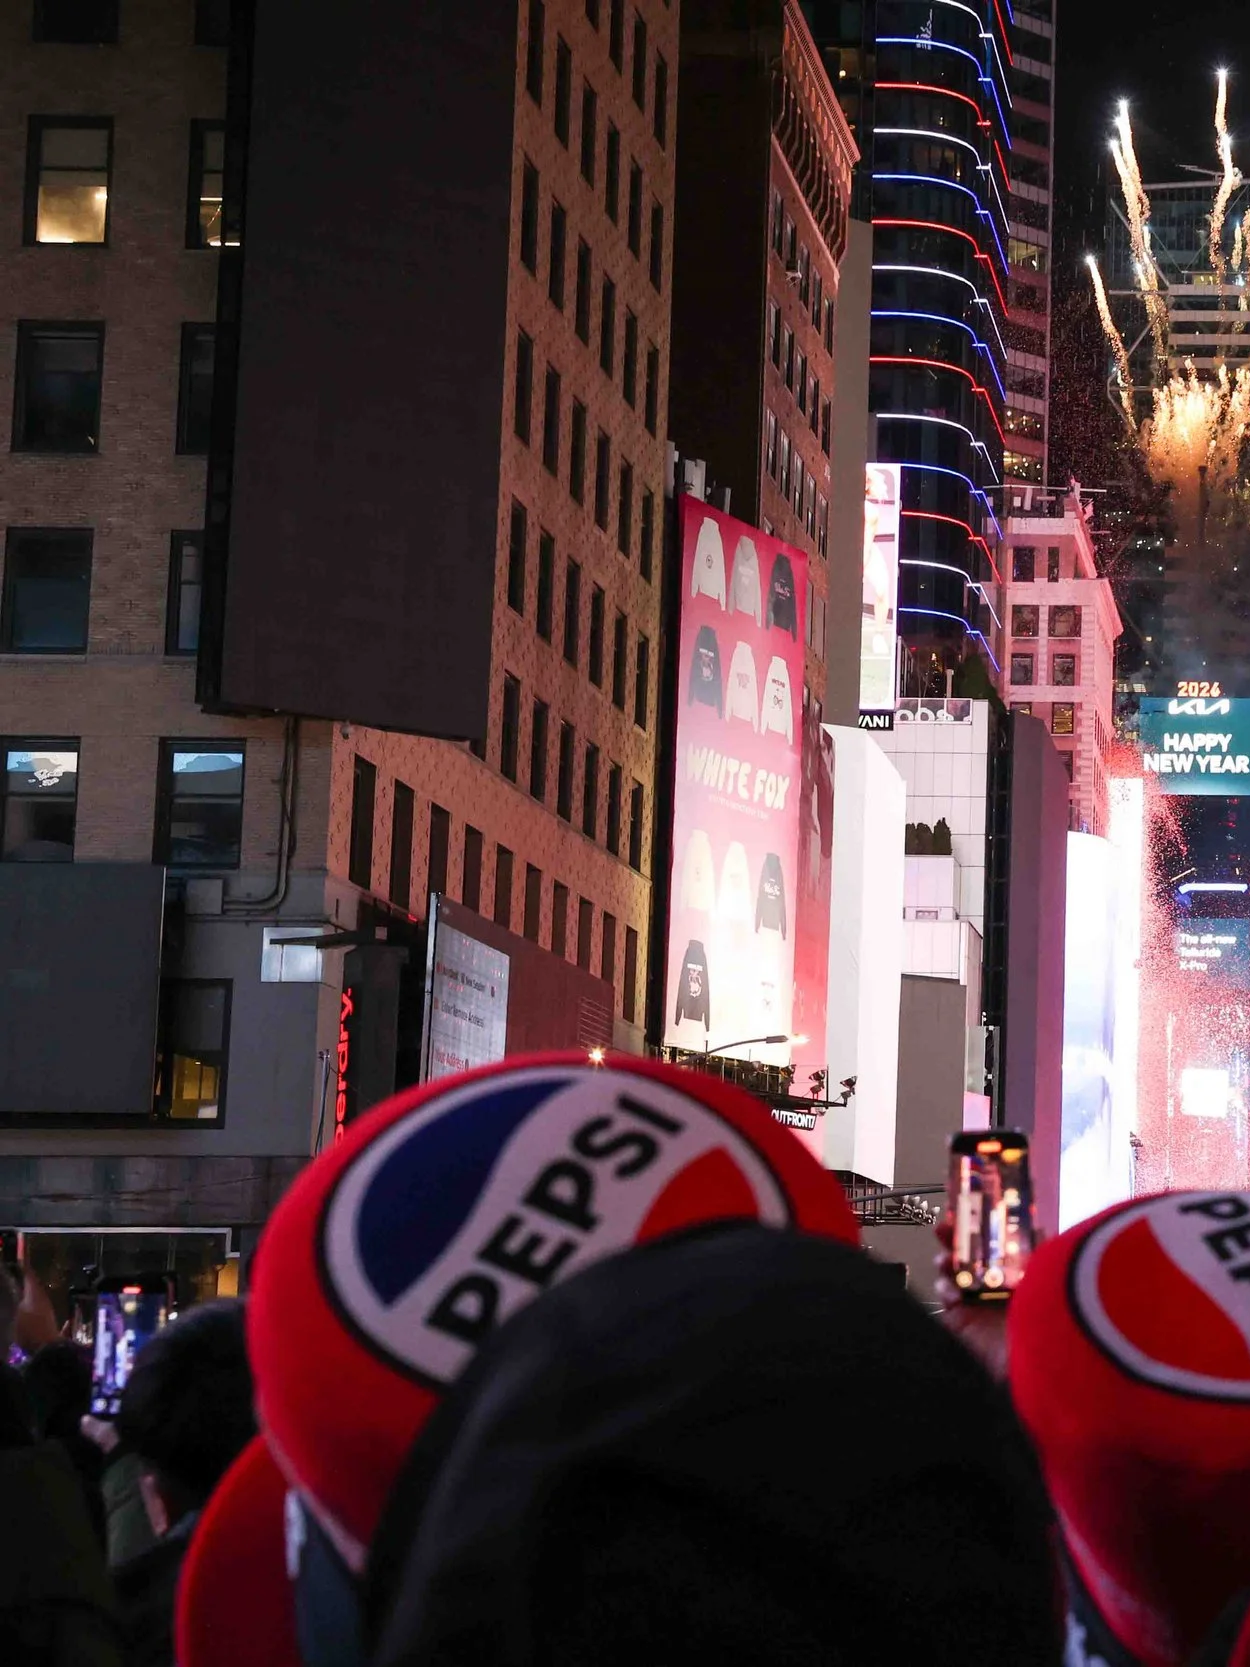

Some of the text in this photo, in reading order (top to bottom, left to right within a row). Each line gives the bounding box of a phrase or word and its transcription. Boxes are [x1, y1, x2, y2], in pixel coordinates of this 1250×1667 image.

[1177, 681, 1221, 697] 2026
[1163, 732, 1232, 752] HAPPY
[1143, 753, 1250, 773] NEW YEAR
[686, 743, 752, 800] WHITE
[753, 768, 790, 811] FOX
[427, 1093, 687, 1344] PEPSI
